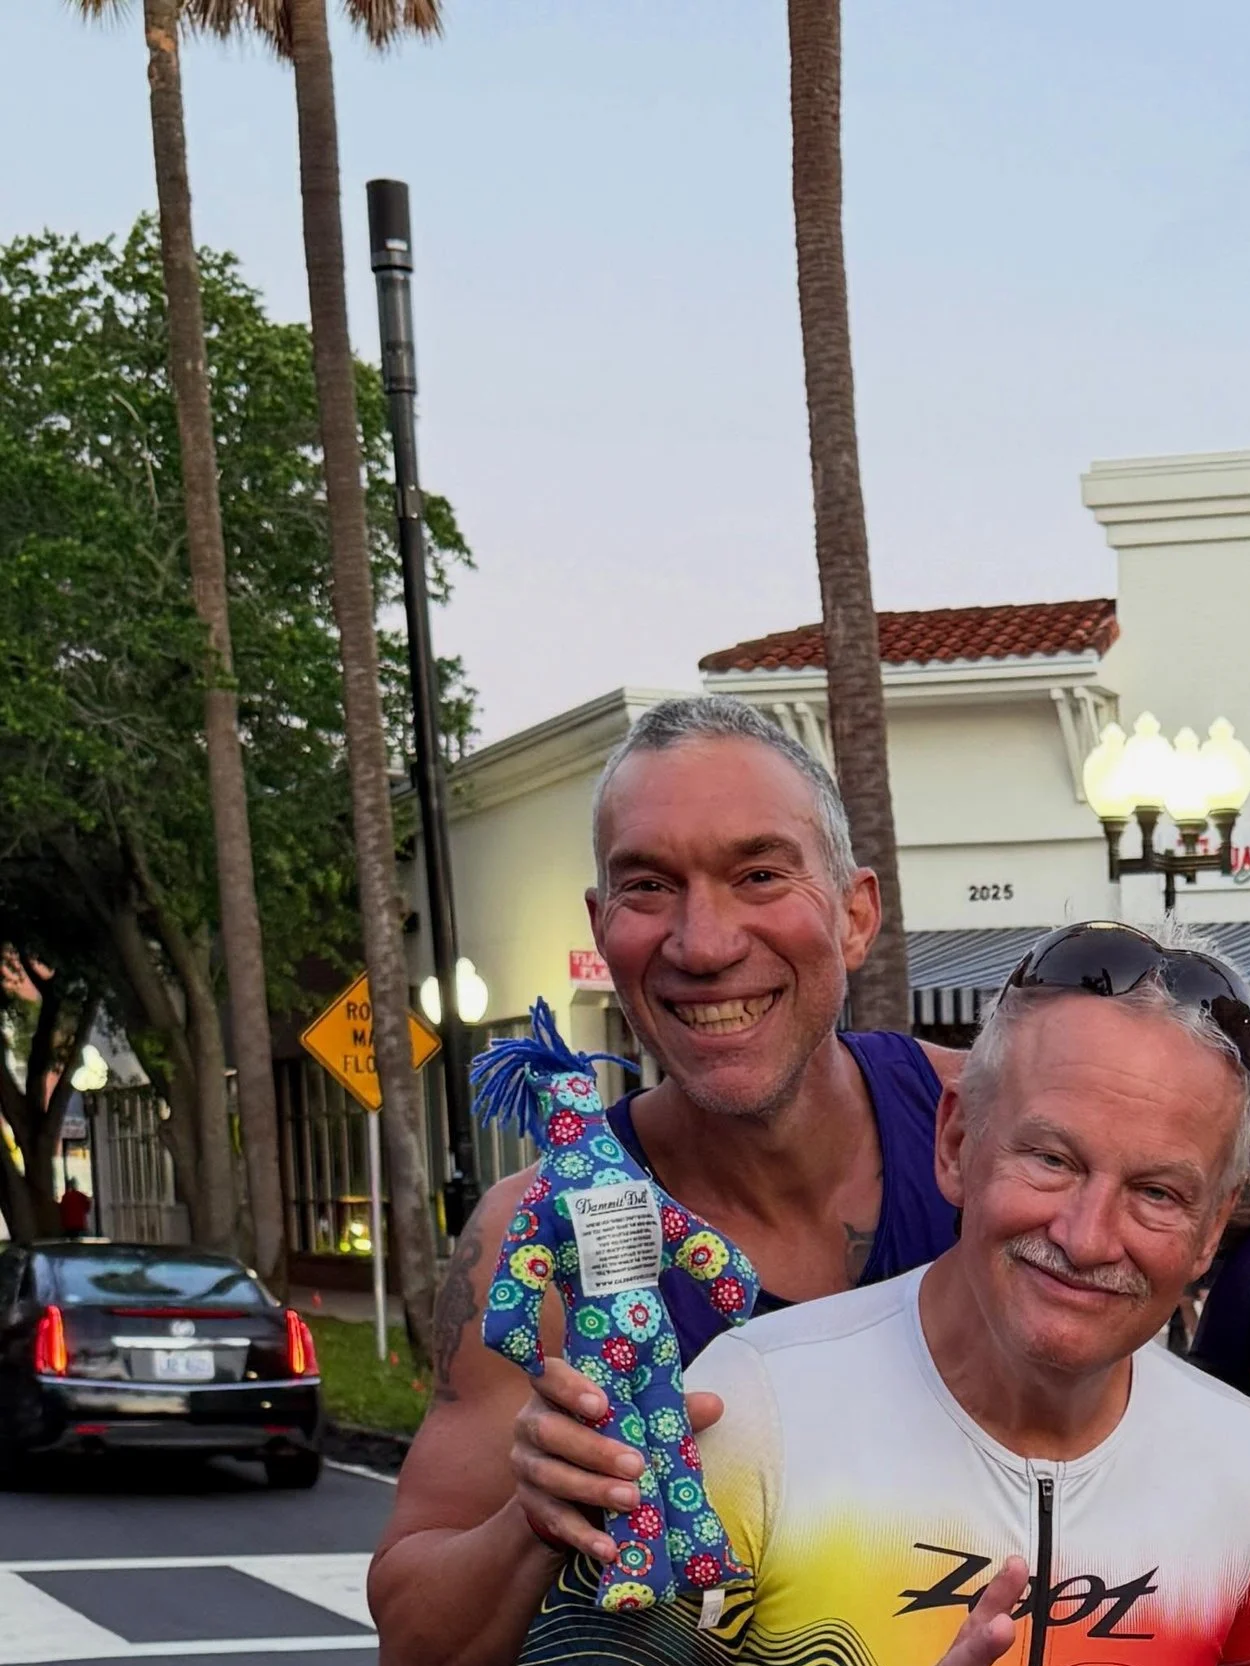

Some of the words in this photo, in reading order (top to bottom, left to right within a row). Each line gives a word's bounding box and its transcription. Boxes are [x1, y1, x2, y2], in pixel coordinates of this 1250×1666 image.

[969, 884, 1014, 901] 2025
[346, 1002, 371, 1020] RO
[344, 1055, 376, 1073] FLO
